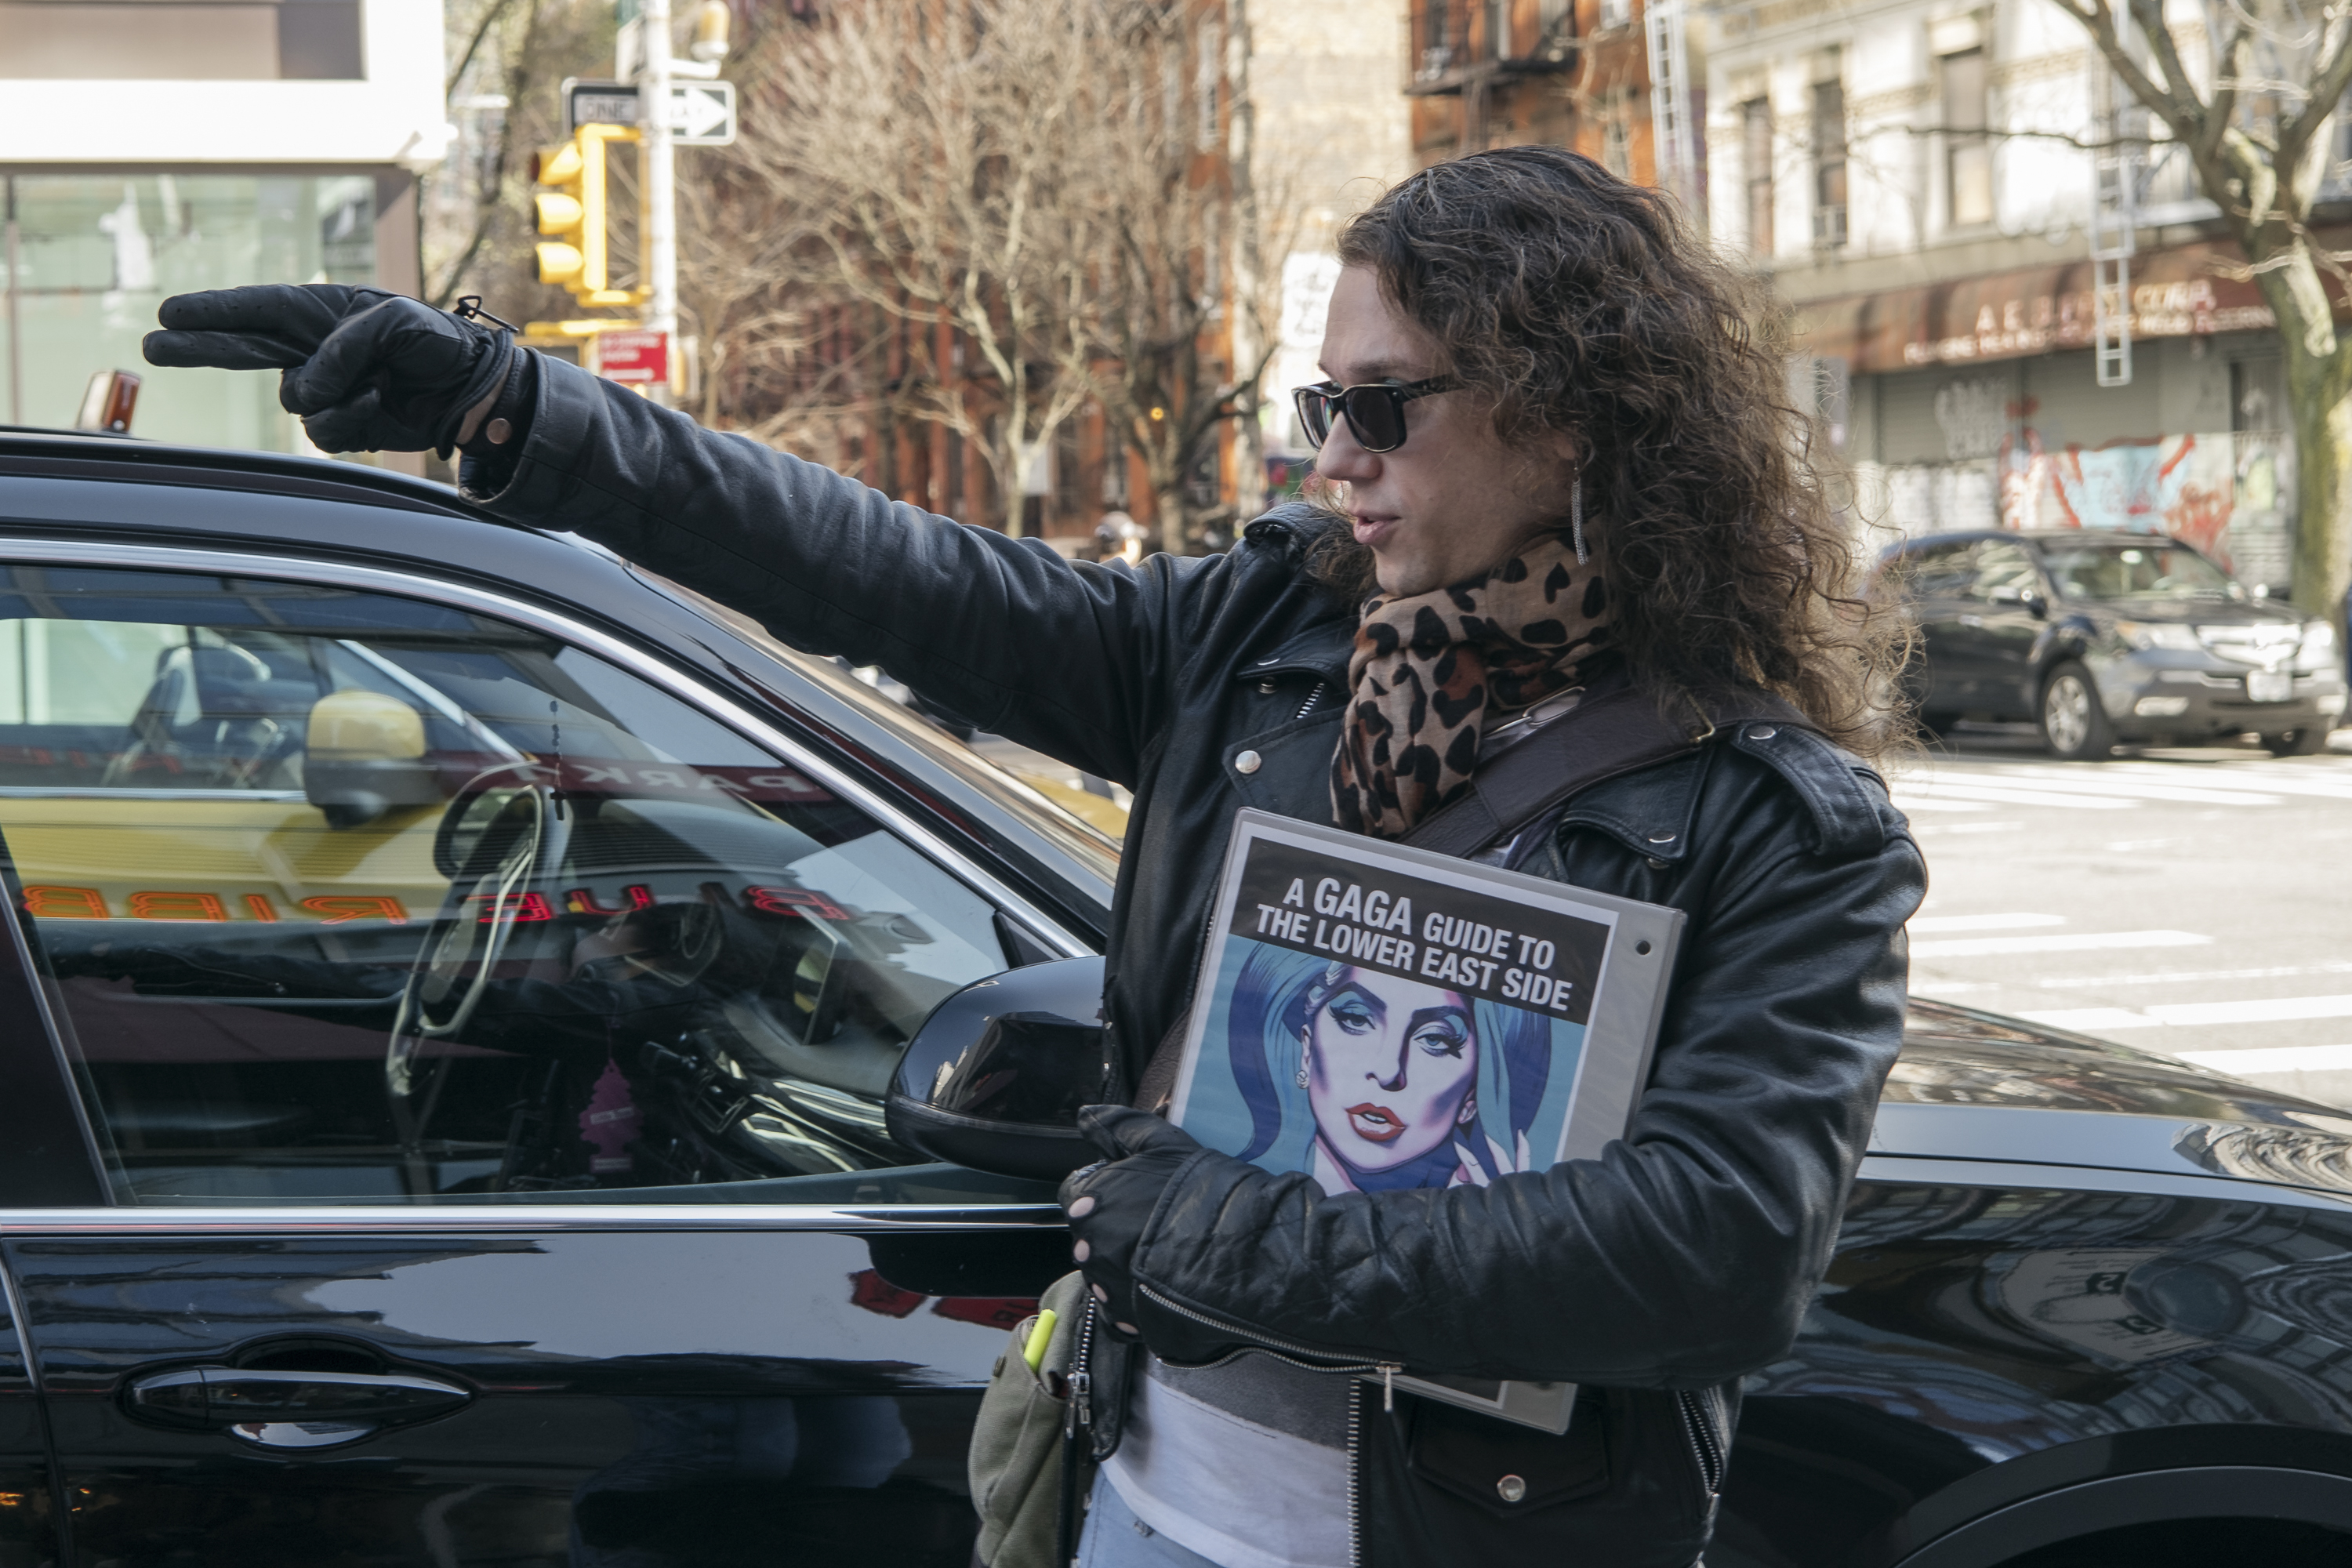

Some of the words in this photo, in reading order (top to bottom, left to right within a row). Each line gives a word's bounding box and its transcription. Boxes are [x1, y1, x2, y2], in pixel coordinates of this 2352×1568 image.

[1257, 903, 1312, 944] THE
[1312, 919, 1417, 971] LOWER
[1419, 946, 1500, 991] EAST
[1501, 967, 1573, 1011] SIDE
[1282, 877, 1305, 908] A
[1313, 877, 1412, 935] GAGA
[1422, 912, 1513, 960] GUIDE
[1517, 934, 1555, 971] TO
